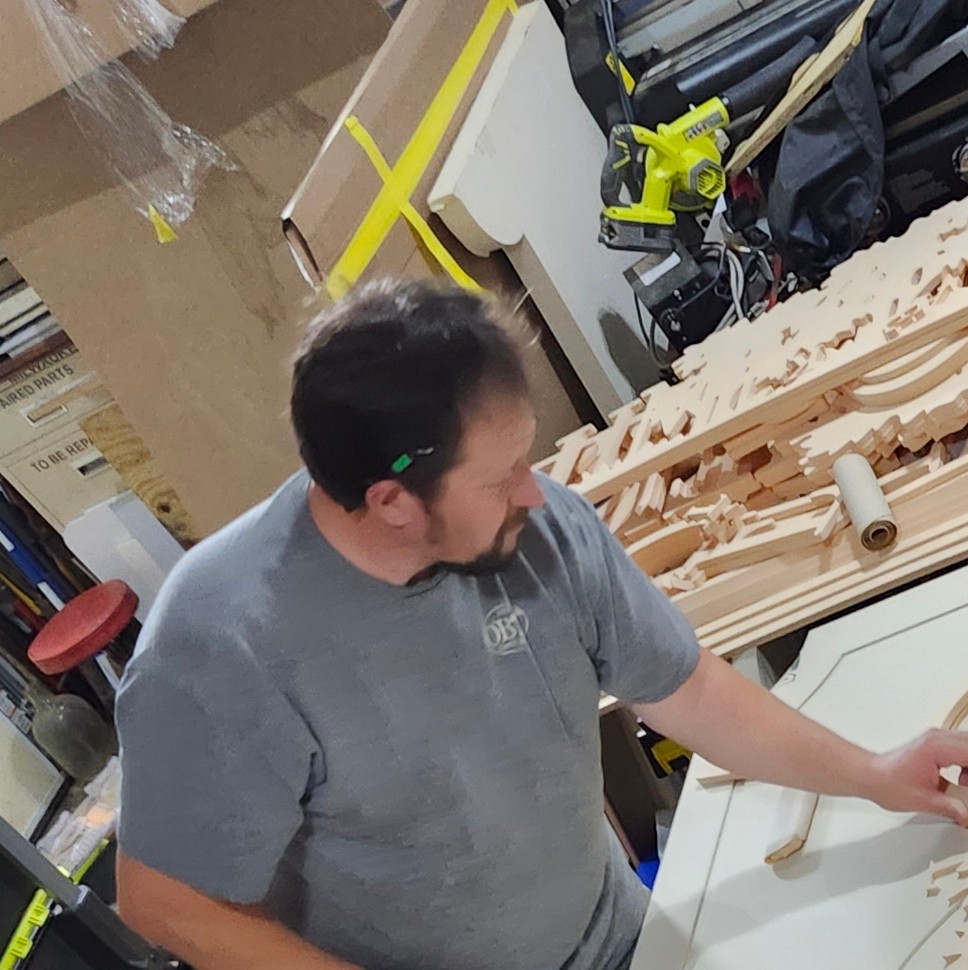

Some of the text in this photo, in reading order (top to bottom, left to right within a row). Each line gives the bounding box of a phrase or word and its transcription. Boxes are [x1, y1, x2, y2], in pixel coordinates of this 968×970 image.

[35, 363, 74, 390] PARTS
[30, 460, 50, 473] TO
[48, 449, 65, 464] BE
